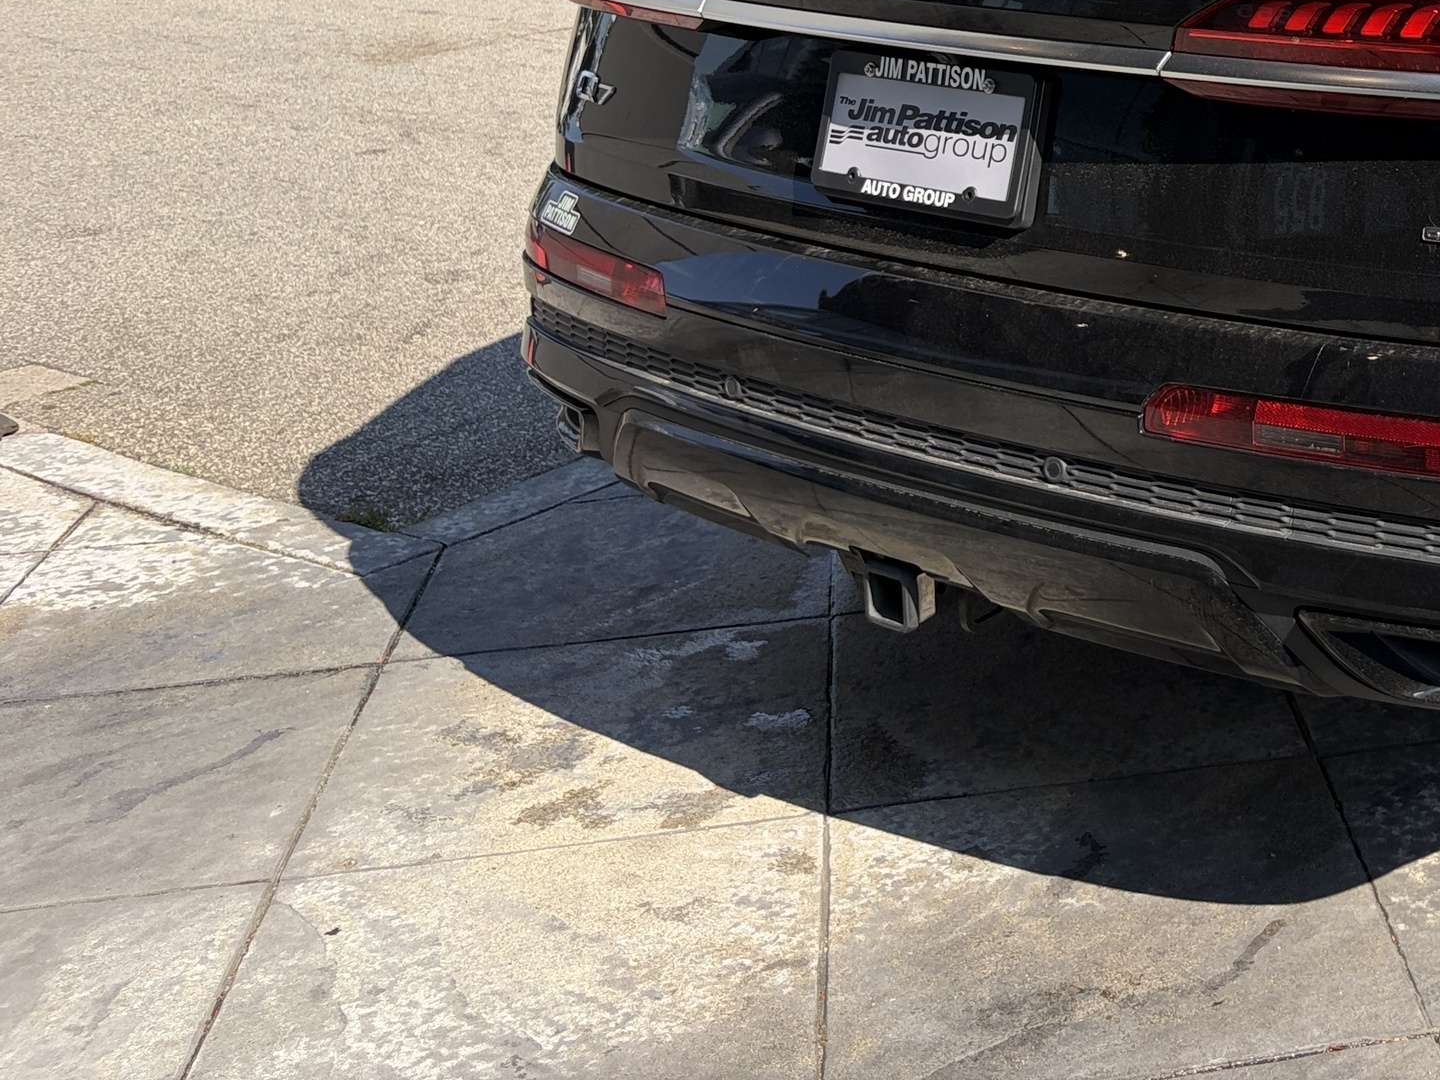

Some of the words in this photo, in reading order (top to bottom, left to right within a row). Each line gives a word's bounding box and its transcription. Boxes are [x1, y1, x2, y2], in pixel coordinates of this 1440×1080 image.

[576, 70, 617, 105] Q7
[874, 56, 904, 81] JIM
[906, 59, 986, 92] PATTISON
[839, 95, 857, 106] The
[847, 98, 897, 126] Jim
[899, 103, 1018, 142] Pattison
[558, 193, 577, 212] JIM
[860, 178, 901, 199] AUTO
[903, 185, 956, 208] GROUP
[543, 203, 580, 233] PATTISON
